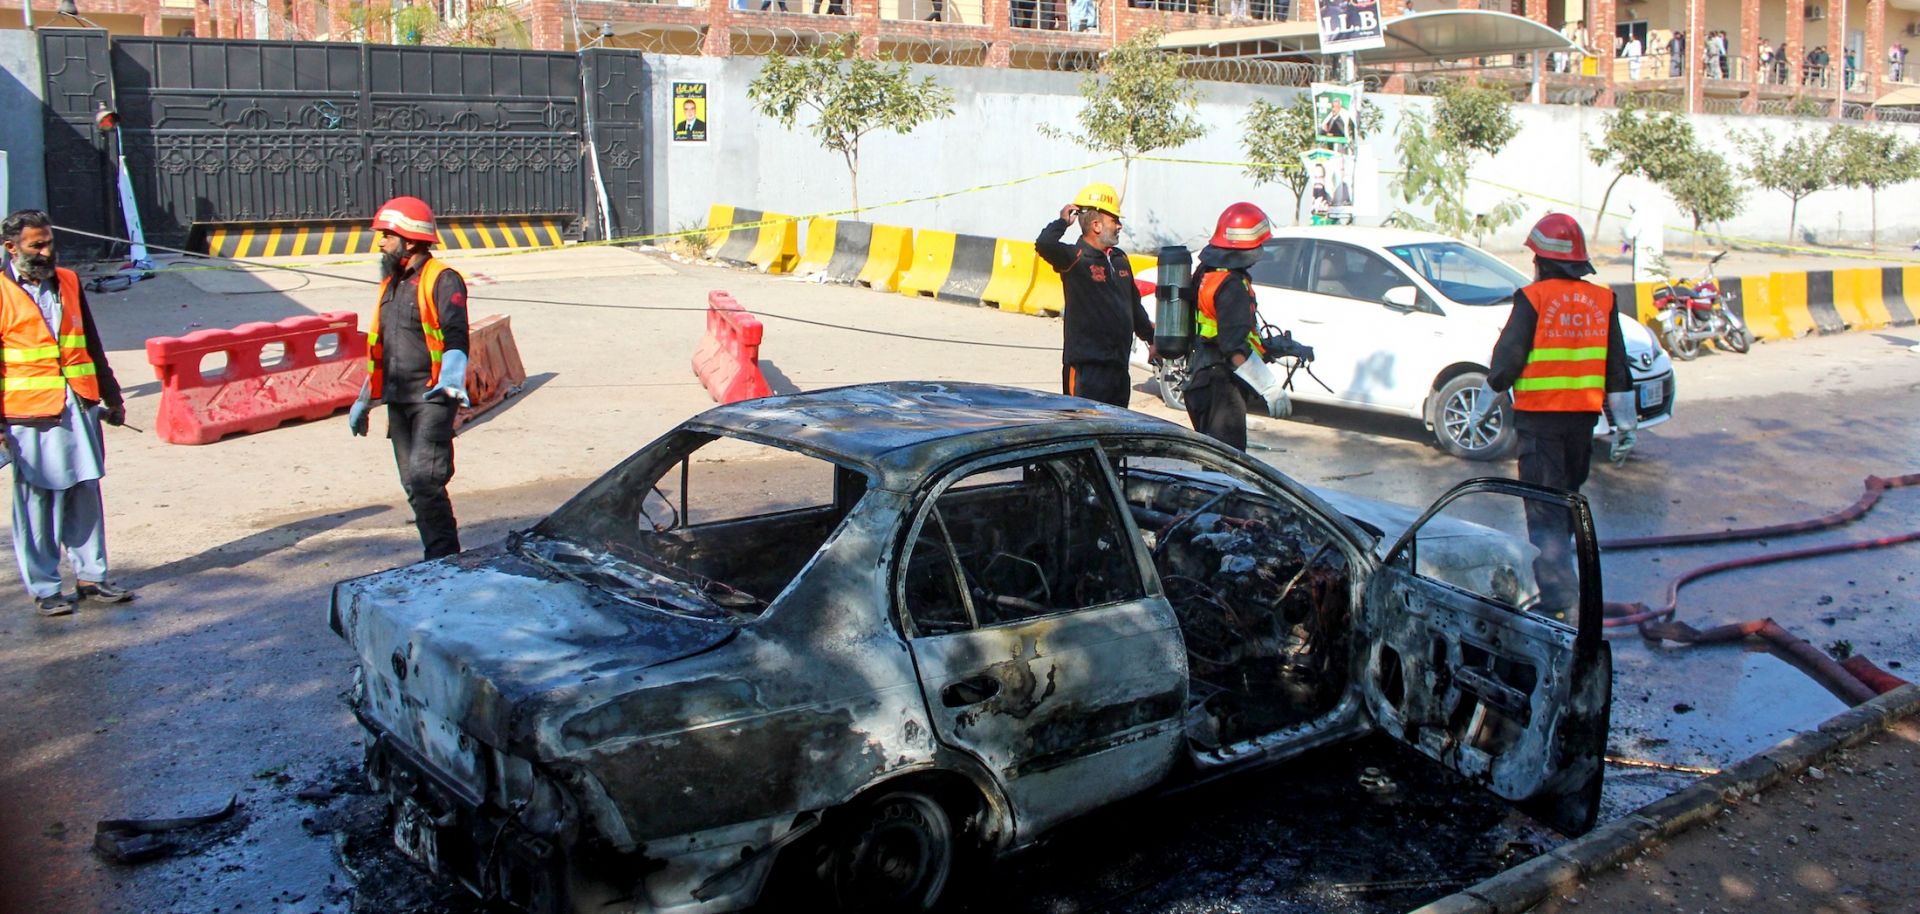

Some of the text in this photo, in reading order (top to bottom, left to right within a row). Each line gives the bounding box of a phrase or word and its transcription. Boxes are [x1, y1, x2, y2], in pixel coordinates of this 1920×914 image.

[1322, 11, 1378, 34] LL.B
[1544, 299, 1561, 324] FIRE
[1574, 293, 1606, 324] RESCUE
[1559, 313, 1591, 327] MCI
[1545, 328, 1607, 338] ISLAMABAD
